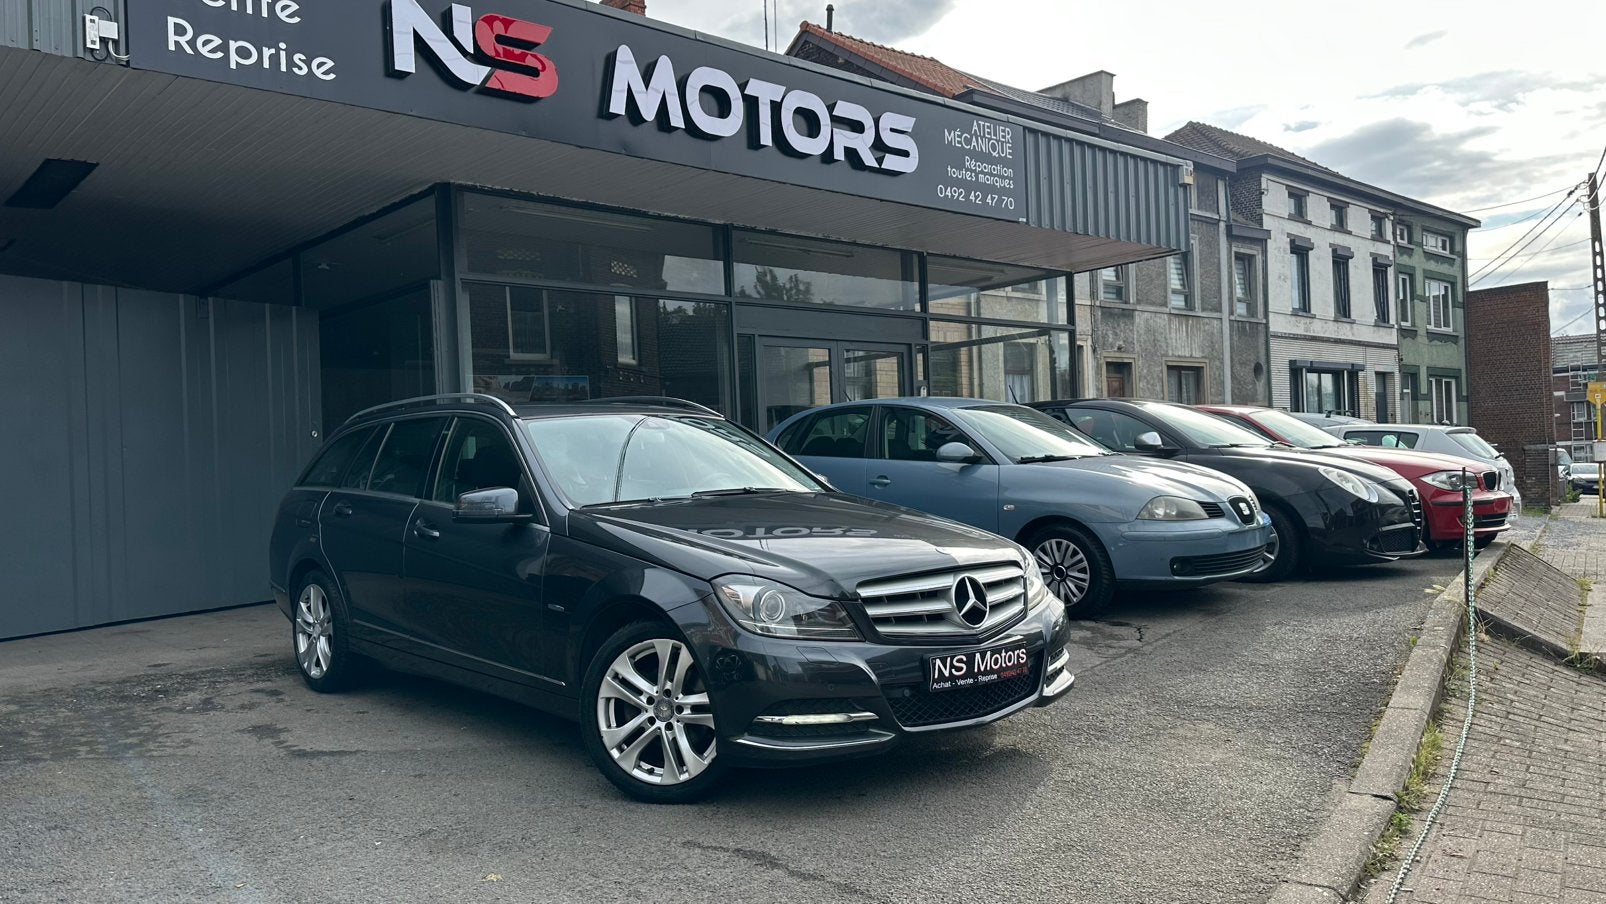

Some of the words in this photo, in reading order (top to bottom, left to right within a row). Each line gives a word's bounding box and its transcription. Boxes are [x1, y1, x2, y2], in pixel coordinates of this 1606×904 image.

[167, 16, 336, 80] Reprise
[390, 0, 559, 98] NS
[608, 44, 919, 174] MOTORS
[944, 128, 1013, 158] MÉCANIQUE
[972, 120, 1012, 143] ATELIER
[947, 165, 976, 181] toutes
[978, 173, 1014, 188] marques
[965, 156, 1013, 177] Réparation
[937, 184, 965, 201] 0492
[969, 190, 982, 204] 42
[986, 194, 998, 206] 47
[1001, 196, 1015, 210] 70
[934, 655, 967, 679] NS
[974, 648, 1027, 673] Motors
[932, 681, 951, 689] Achat
[955, 678, 974, 686] Vente
[978, 673, 998, 683] Reprise
